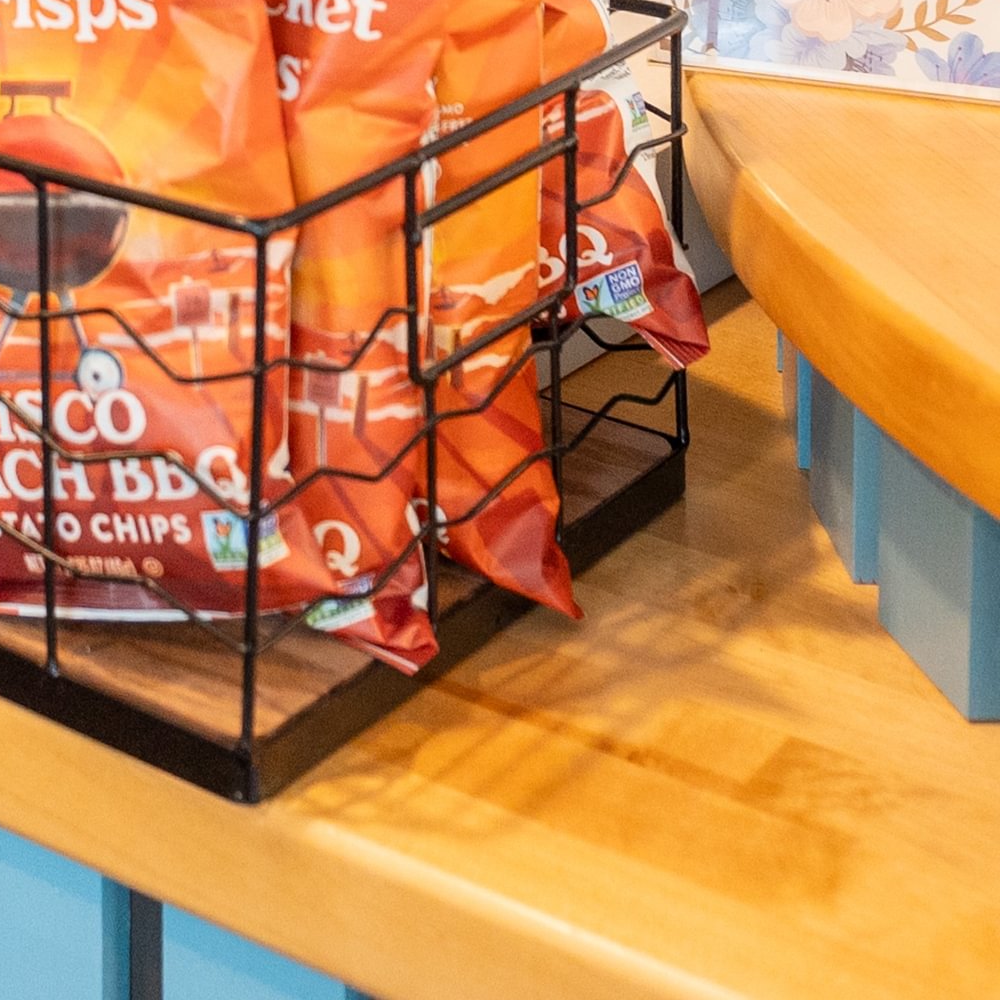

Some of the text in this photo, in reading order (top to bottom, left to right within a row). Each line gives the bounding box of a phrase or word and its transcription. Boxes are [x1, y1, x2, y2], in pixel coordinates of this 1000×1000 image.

[607, 265, 638, 284] NON
[611, 276, 640, 293] GMO
[110, 445, 250, 504] BBQ
[90, 512, 192, 545] CHIPS
